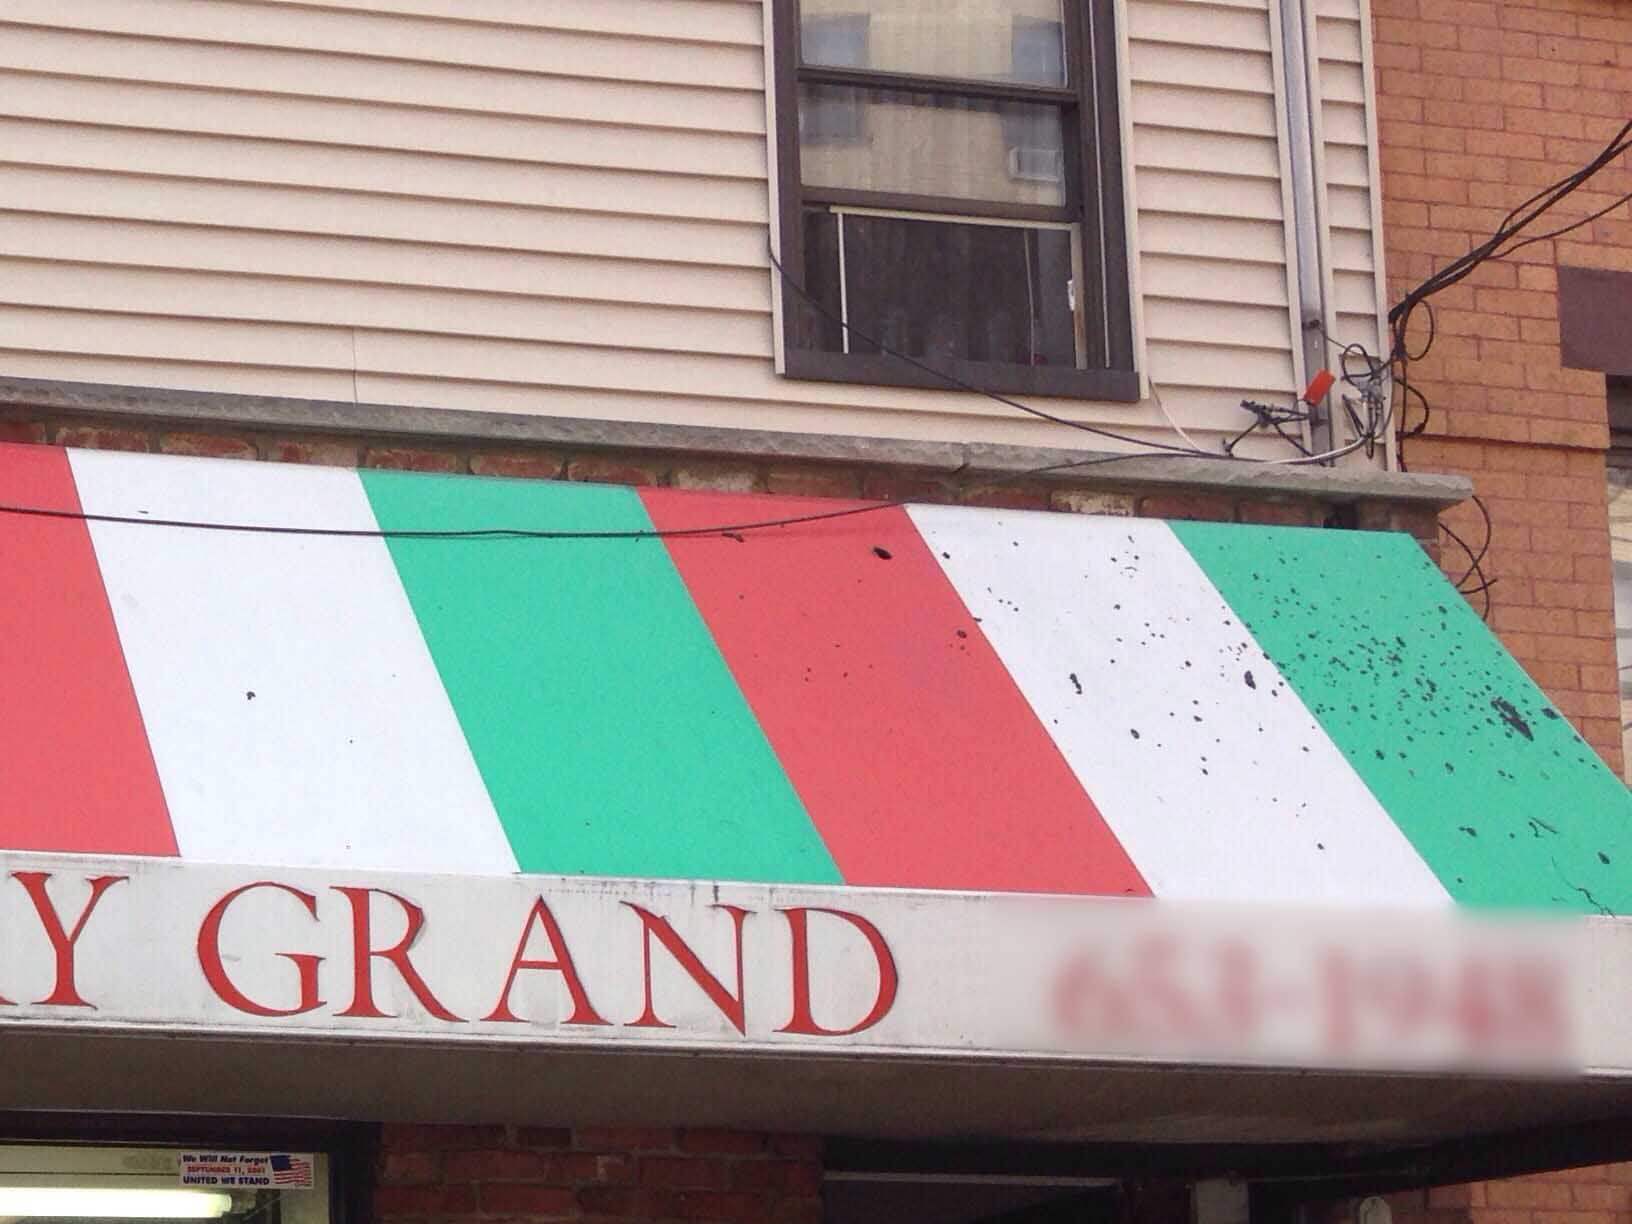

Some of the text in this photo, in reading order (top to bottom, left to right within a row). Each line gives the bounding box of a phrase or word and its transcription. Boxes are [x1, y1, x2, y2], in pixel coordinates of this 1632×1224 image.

[194, 884, 900, 1037] GRAND
[183, 1155, 268, 1166] We Will Not Forget
[187, 1165, 231, 1174] SEPTEMBER
[183, 1176, 270, 1186] UNITED WE STAND
